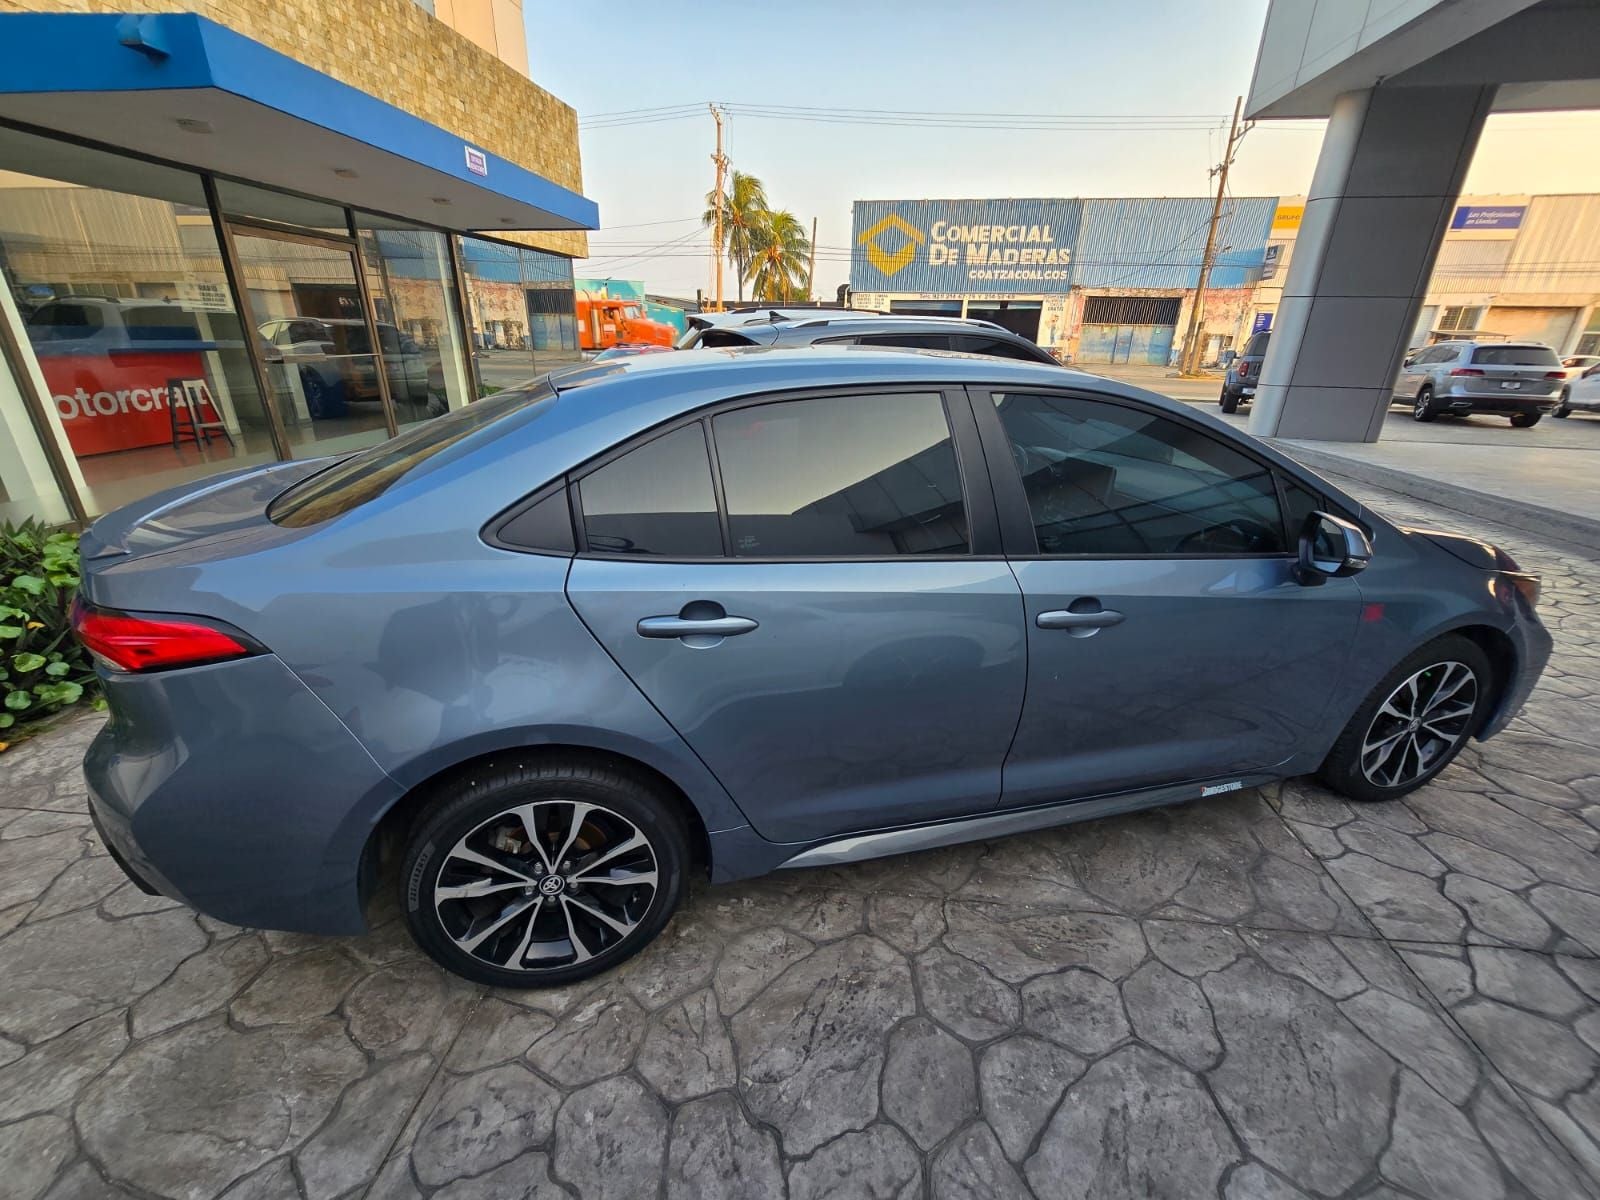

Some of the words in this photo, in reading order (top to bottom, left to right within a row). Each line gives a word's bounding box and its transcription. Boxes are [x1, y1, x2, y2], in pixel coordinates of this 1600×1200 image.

[931, 220, 1054, 242] COMERCIAL
[929, 243, 958, 265] DE
[966, 243, 1071, 265] MADERAS
[969, 270, 1068, 280] COATZACOALCOS
[53, 386, 207, 420] otorcrat
